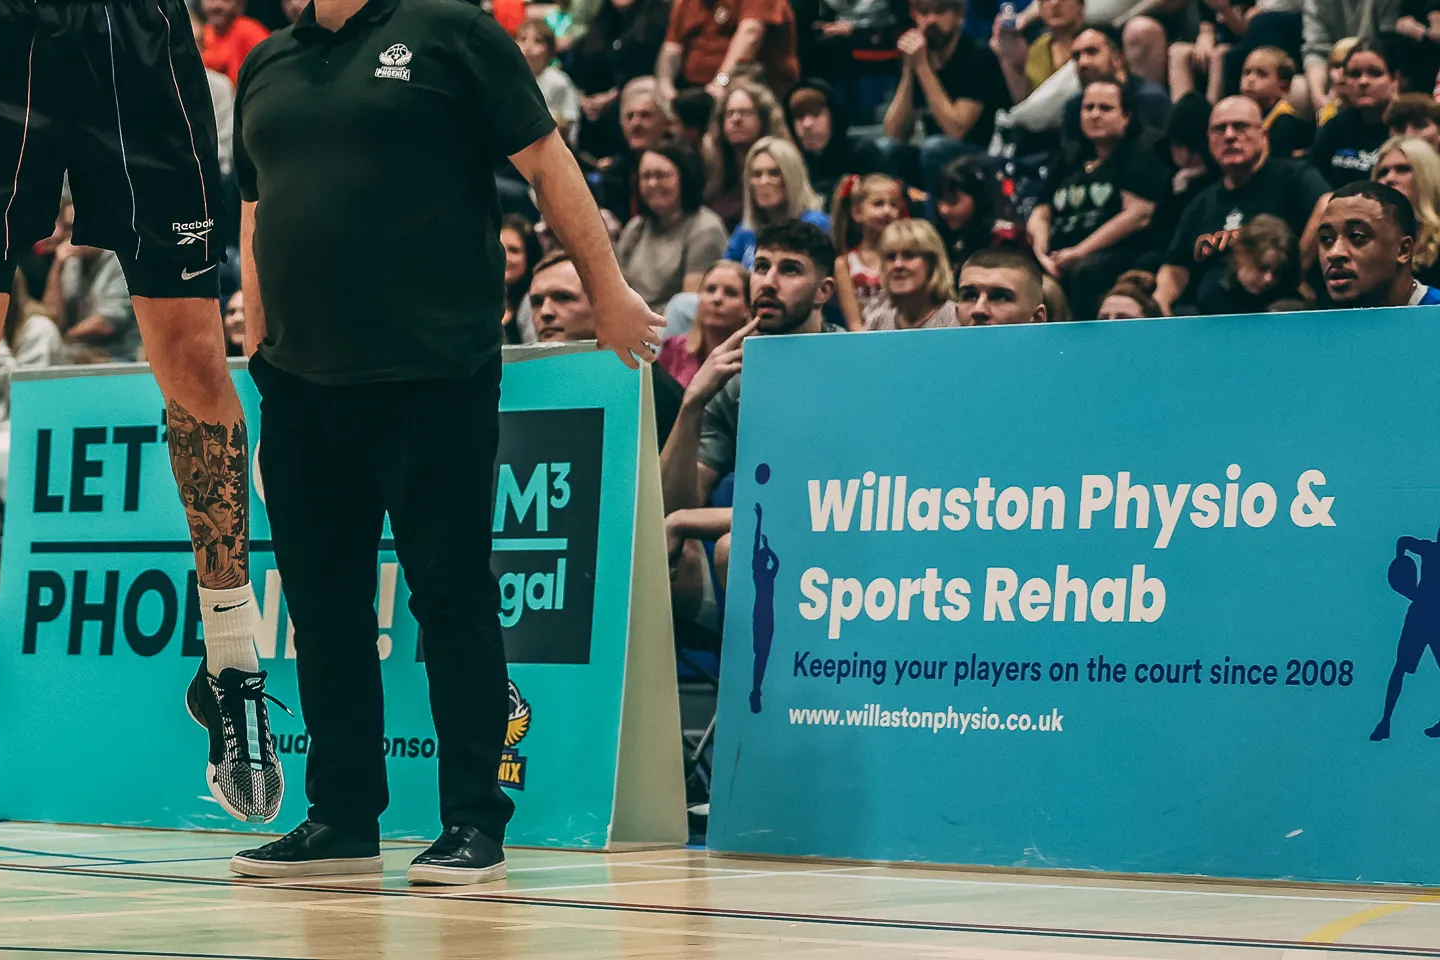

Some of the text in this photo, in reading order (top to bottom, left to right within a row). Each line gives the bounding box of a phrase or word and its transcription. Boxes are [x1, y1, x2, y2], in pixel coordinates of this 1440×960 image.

[172, 218, 215, 232] Reebok
[807, 463, 1337, 549] Willaston Physio &
[497, 558, 567, 628] gal
[798, 564, 1167, 640] Sports Rehab
[793, 651, 1354, 687] Keeping your players on the court since 2008
[788, 703, 1064, 735] www.willastonphysio.co.uk
